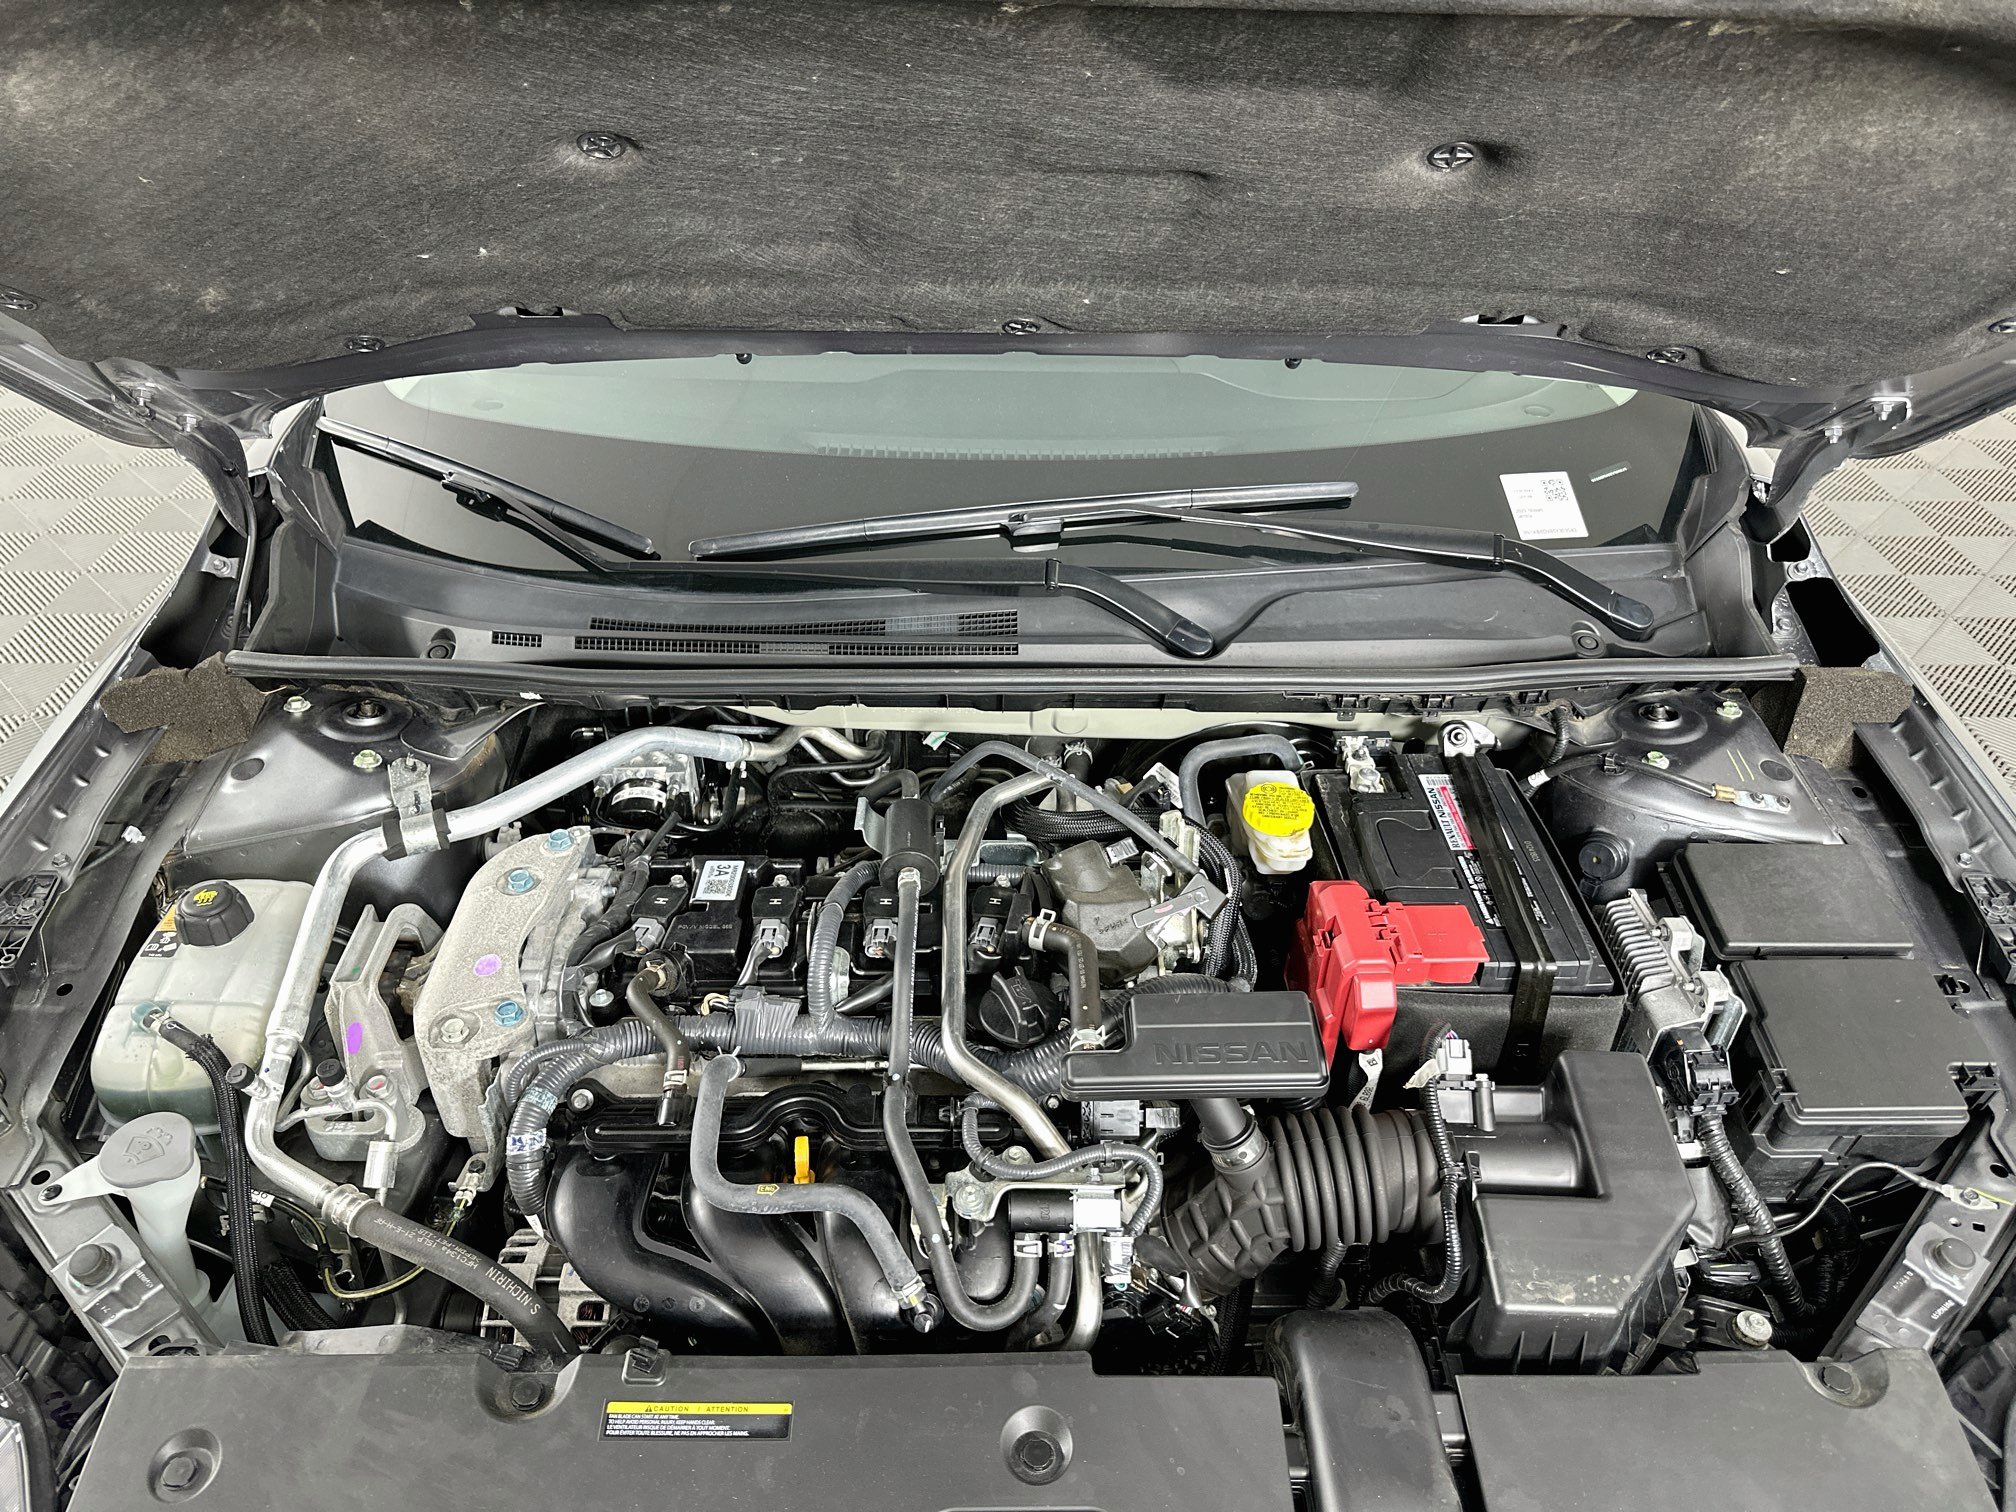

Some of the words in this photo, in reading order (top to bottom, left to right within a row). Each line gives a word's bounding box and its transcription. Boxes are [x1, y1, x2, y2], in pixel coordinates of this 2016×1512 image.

[1426, 787, 1446, 818] NISSAN
[714, 864, 731, 876] 3A
[1153, 1041, 1309, 1064] NISSAN
[416, 1236, 437, 1248] 15LP
[441, 1245, 479, 1270] HFC134a
